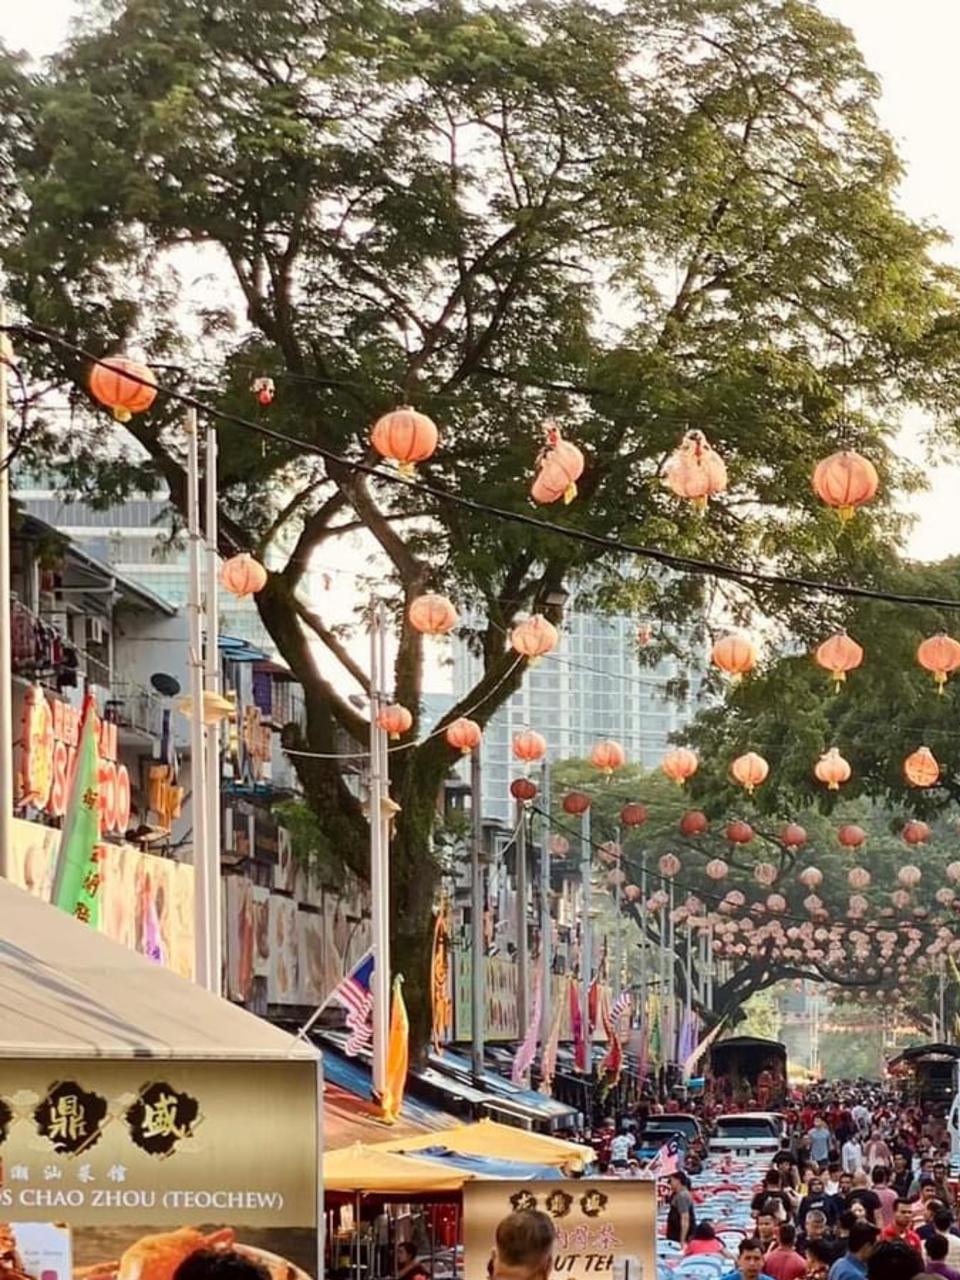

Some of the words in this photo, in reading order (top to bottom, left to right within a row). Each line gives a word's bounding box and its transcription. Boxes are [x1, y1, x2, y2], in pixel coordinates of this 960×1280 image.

[48, 1092, 192, 1140] 鼎盛
[0, 1189, 13, 1207] S
[19, 1189, 84, 1207] CHAO
[91, 1190, 155, 1208] ZHOU
[162, 1191, 284, 1209] (TEOCHEW)
[554, 1254, 581, 1272] UT
